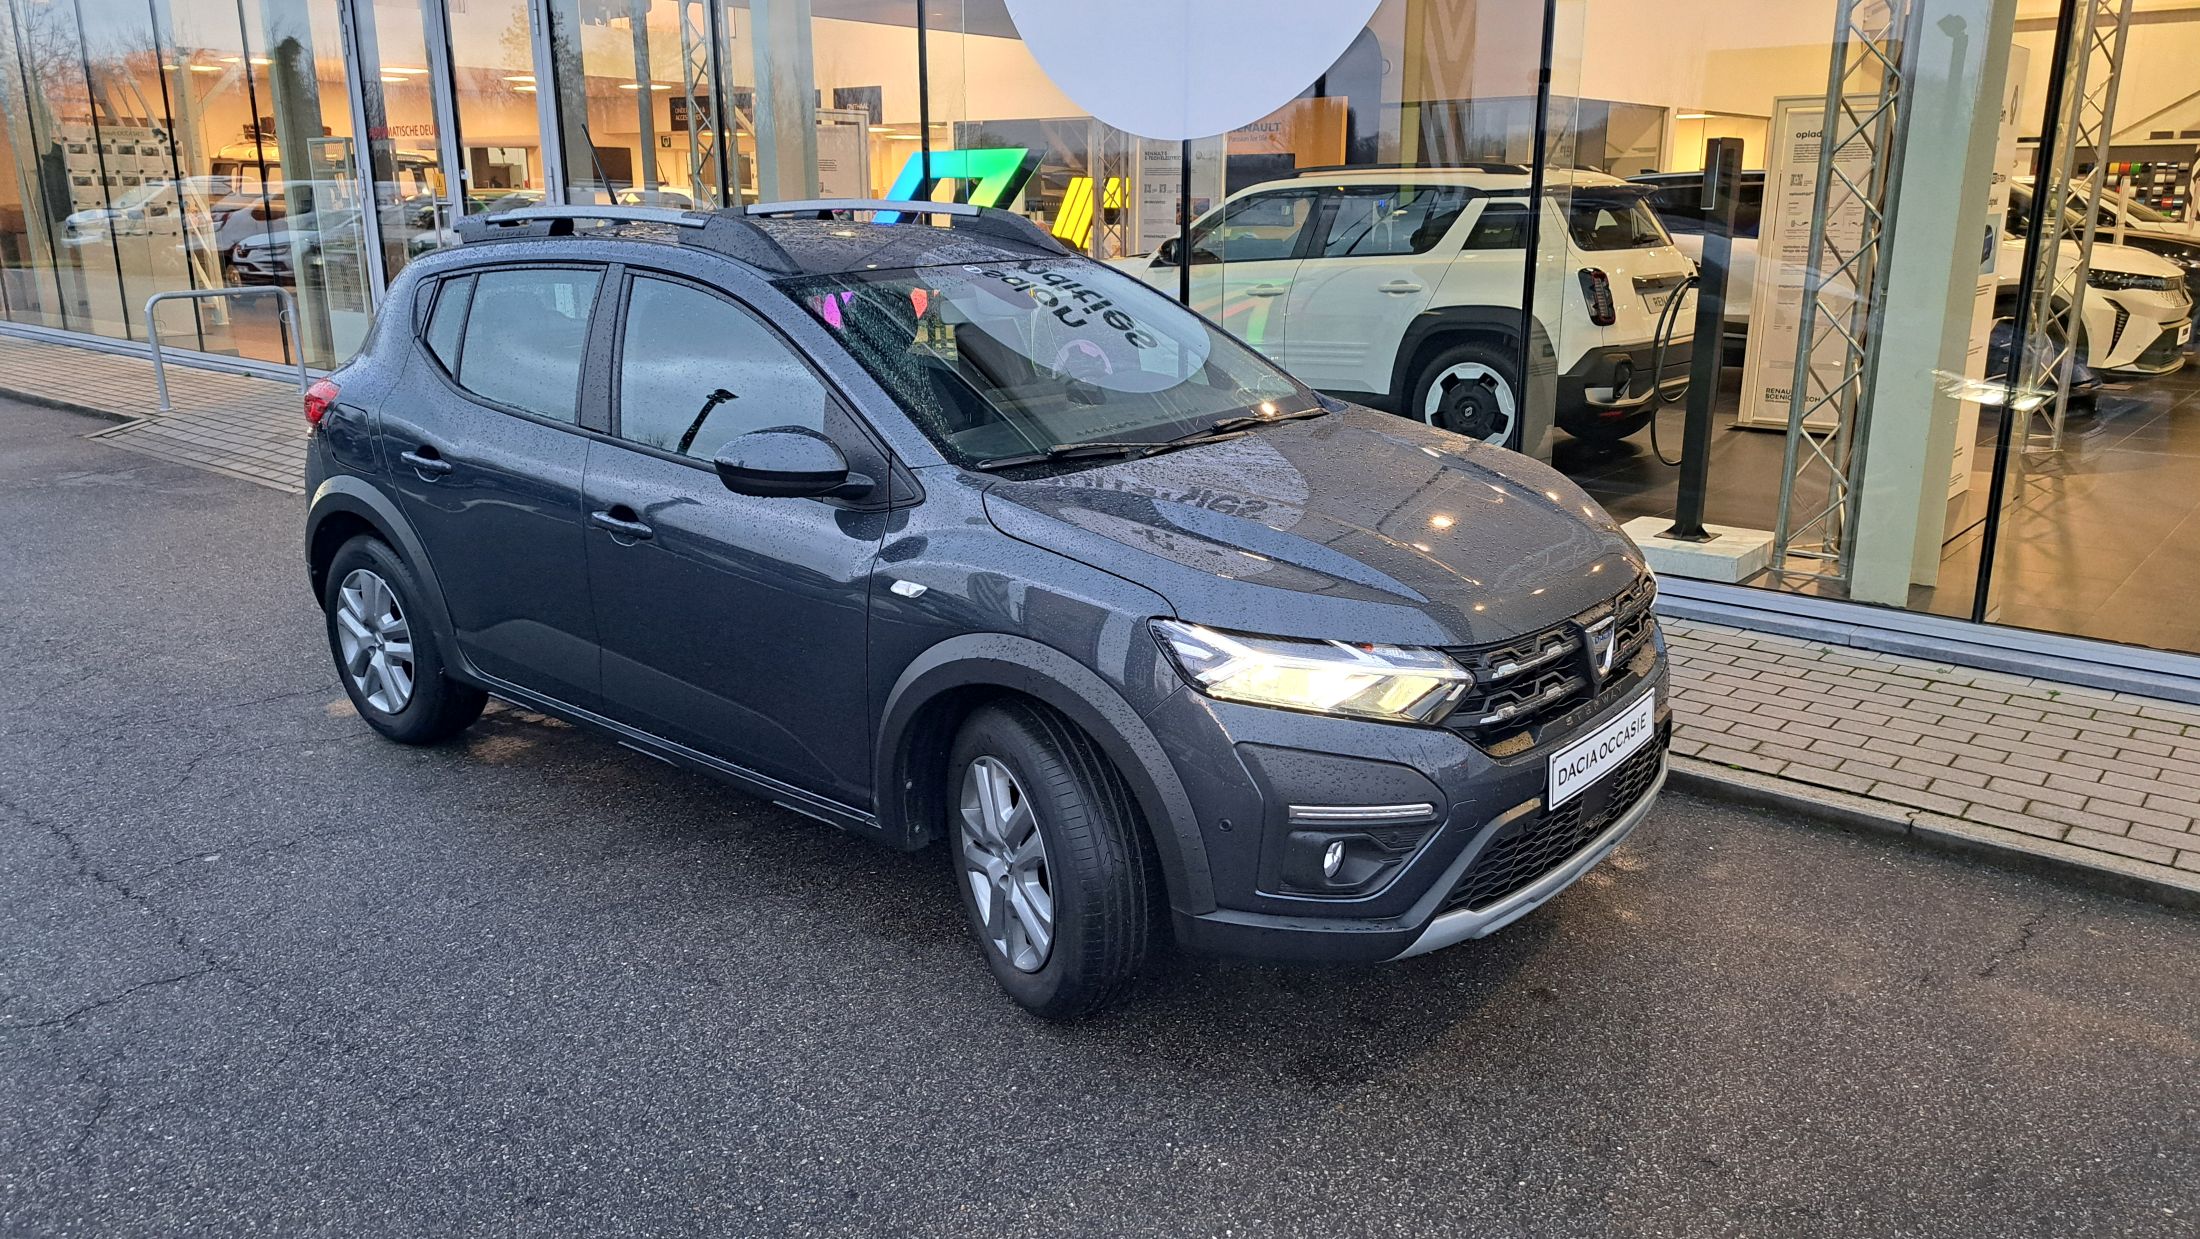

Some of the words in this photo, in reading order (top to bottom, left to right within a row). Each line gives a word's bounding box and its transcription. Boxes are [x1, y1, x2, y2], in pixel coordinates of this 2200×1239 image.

[1234, 122, 1281, 133] NAULT
[1795, 130, 1823, 140] oplad
[1765, 387, 1792, 395] RENAU
[1565, 684, 1622, 727] STEPWAY
[1557, 750, 1598, 787] DACIA
[1599, 711, 1648, 760] OCCASIE
